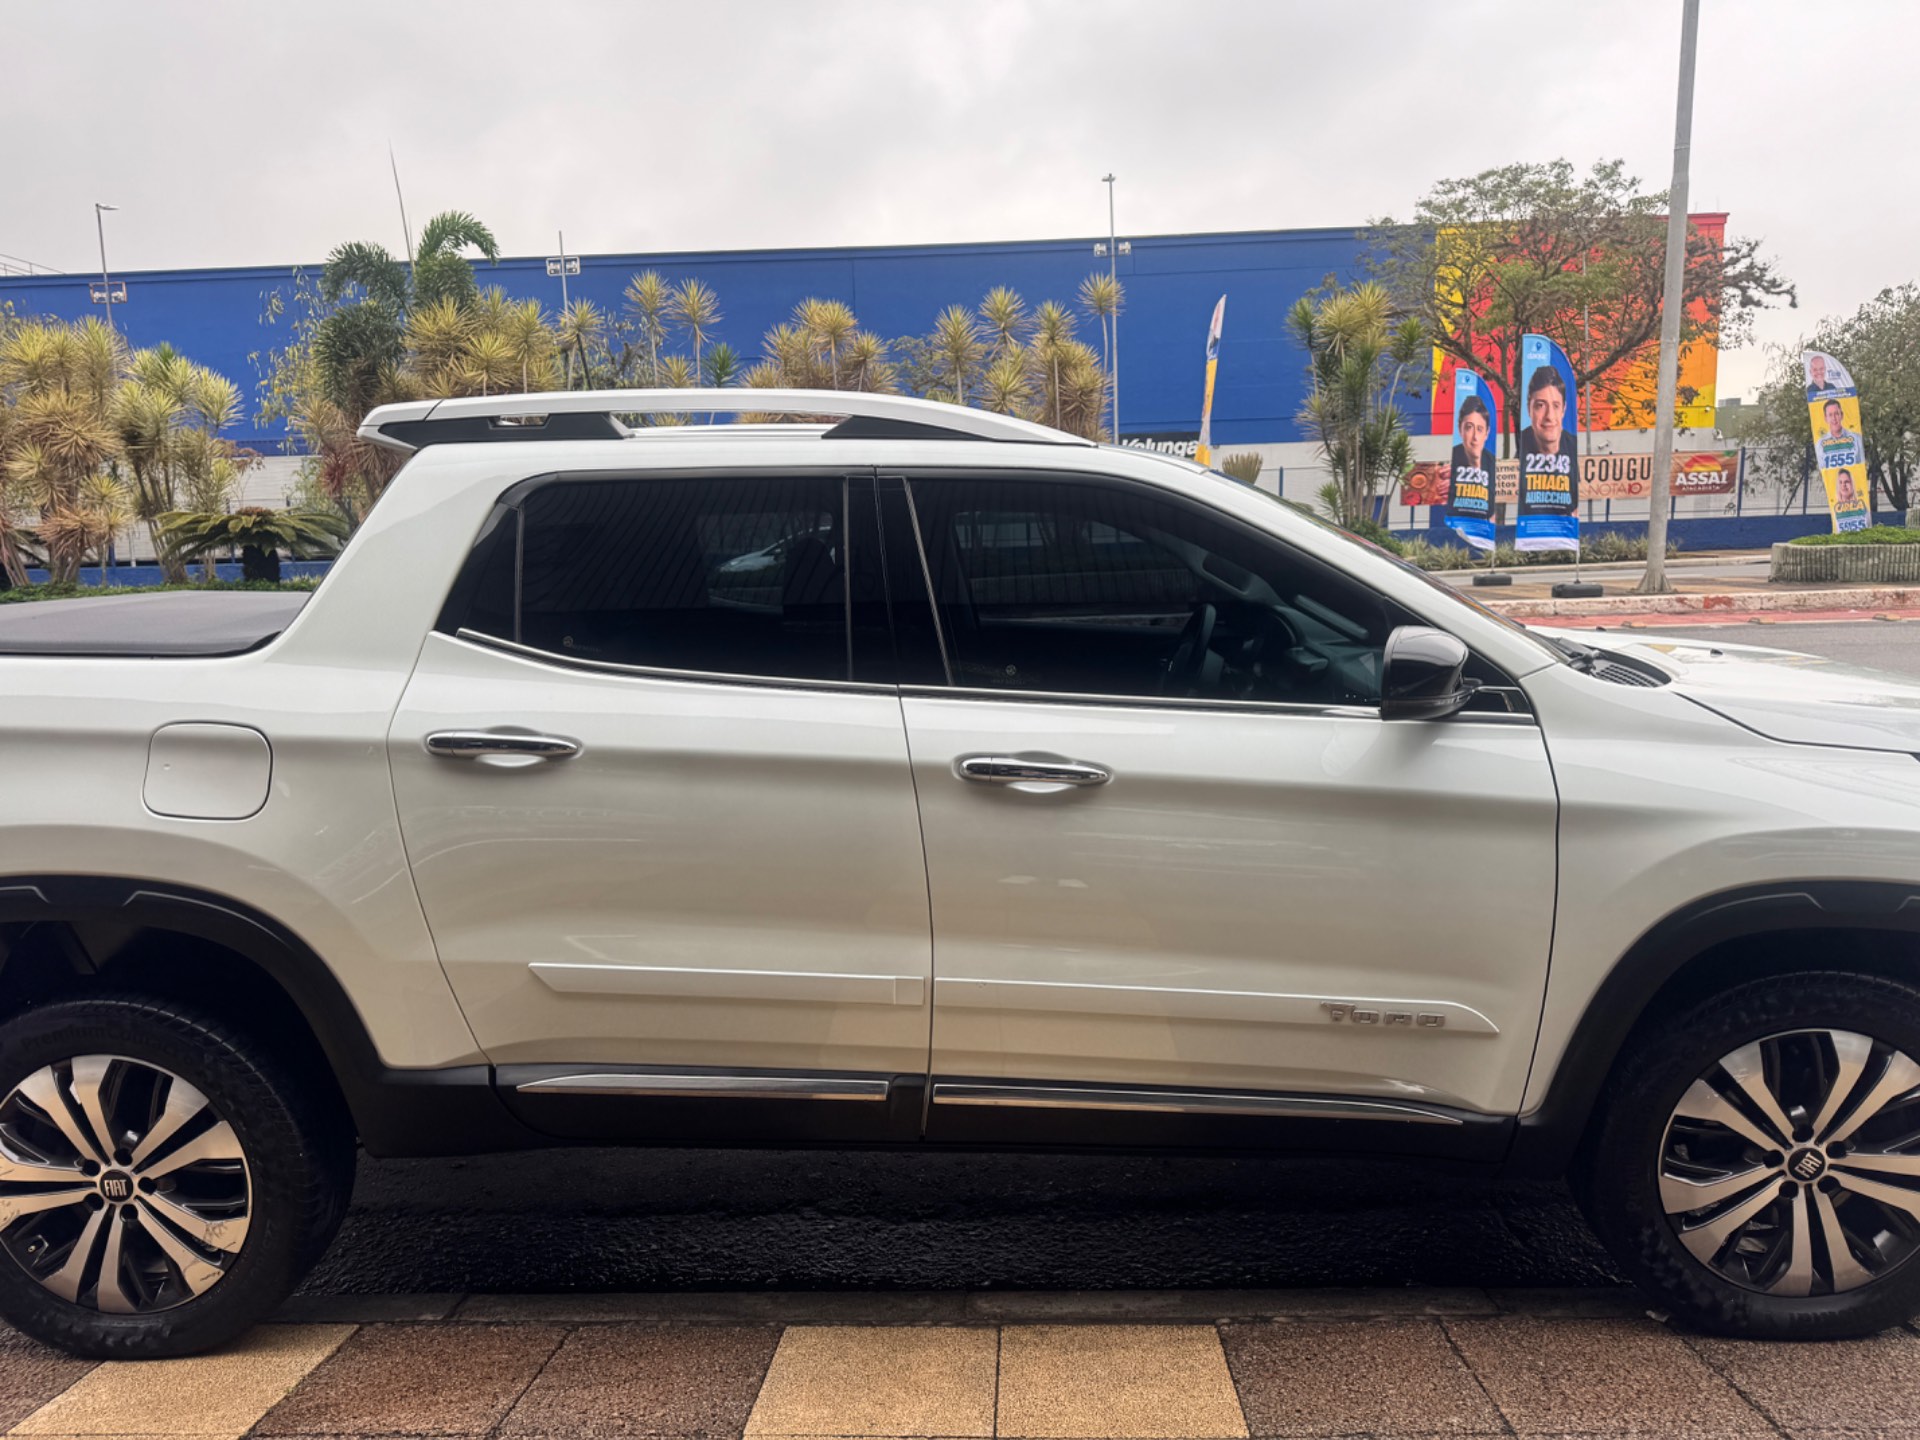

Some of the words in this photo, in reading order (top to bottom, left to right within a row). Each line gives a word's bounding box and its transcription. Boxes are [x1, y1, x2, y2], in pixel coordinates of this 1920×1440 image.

[1526, 453, 1571, 474] 22343
[1824, 452, 1855, 468] 1555
[1578, 457, 1651, 483] ÇOUGU
[1496, 480, 1516, 488] itos
[1794, 1151, 1822, 1179] FIAT
[104, 1179, 127, 1197] FIAT
